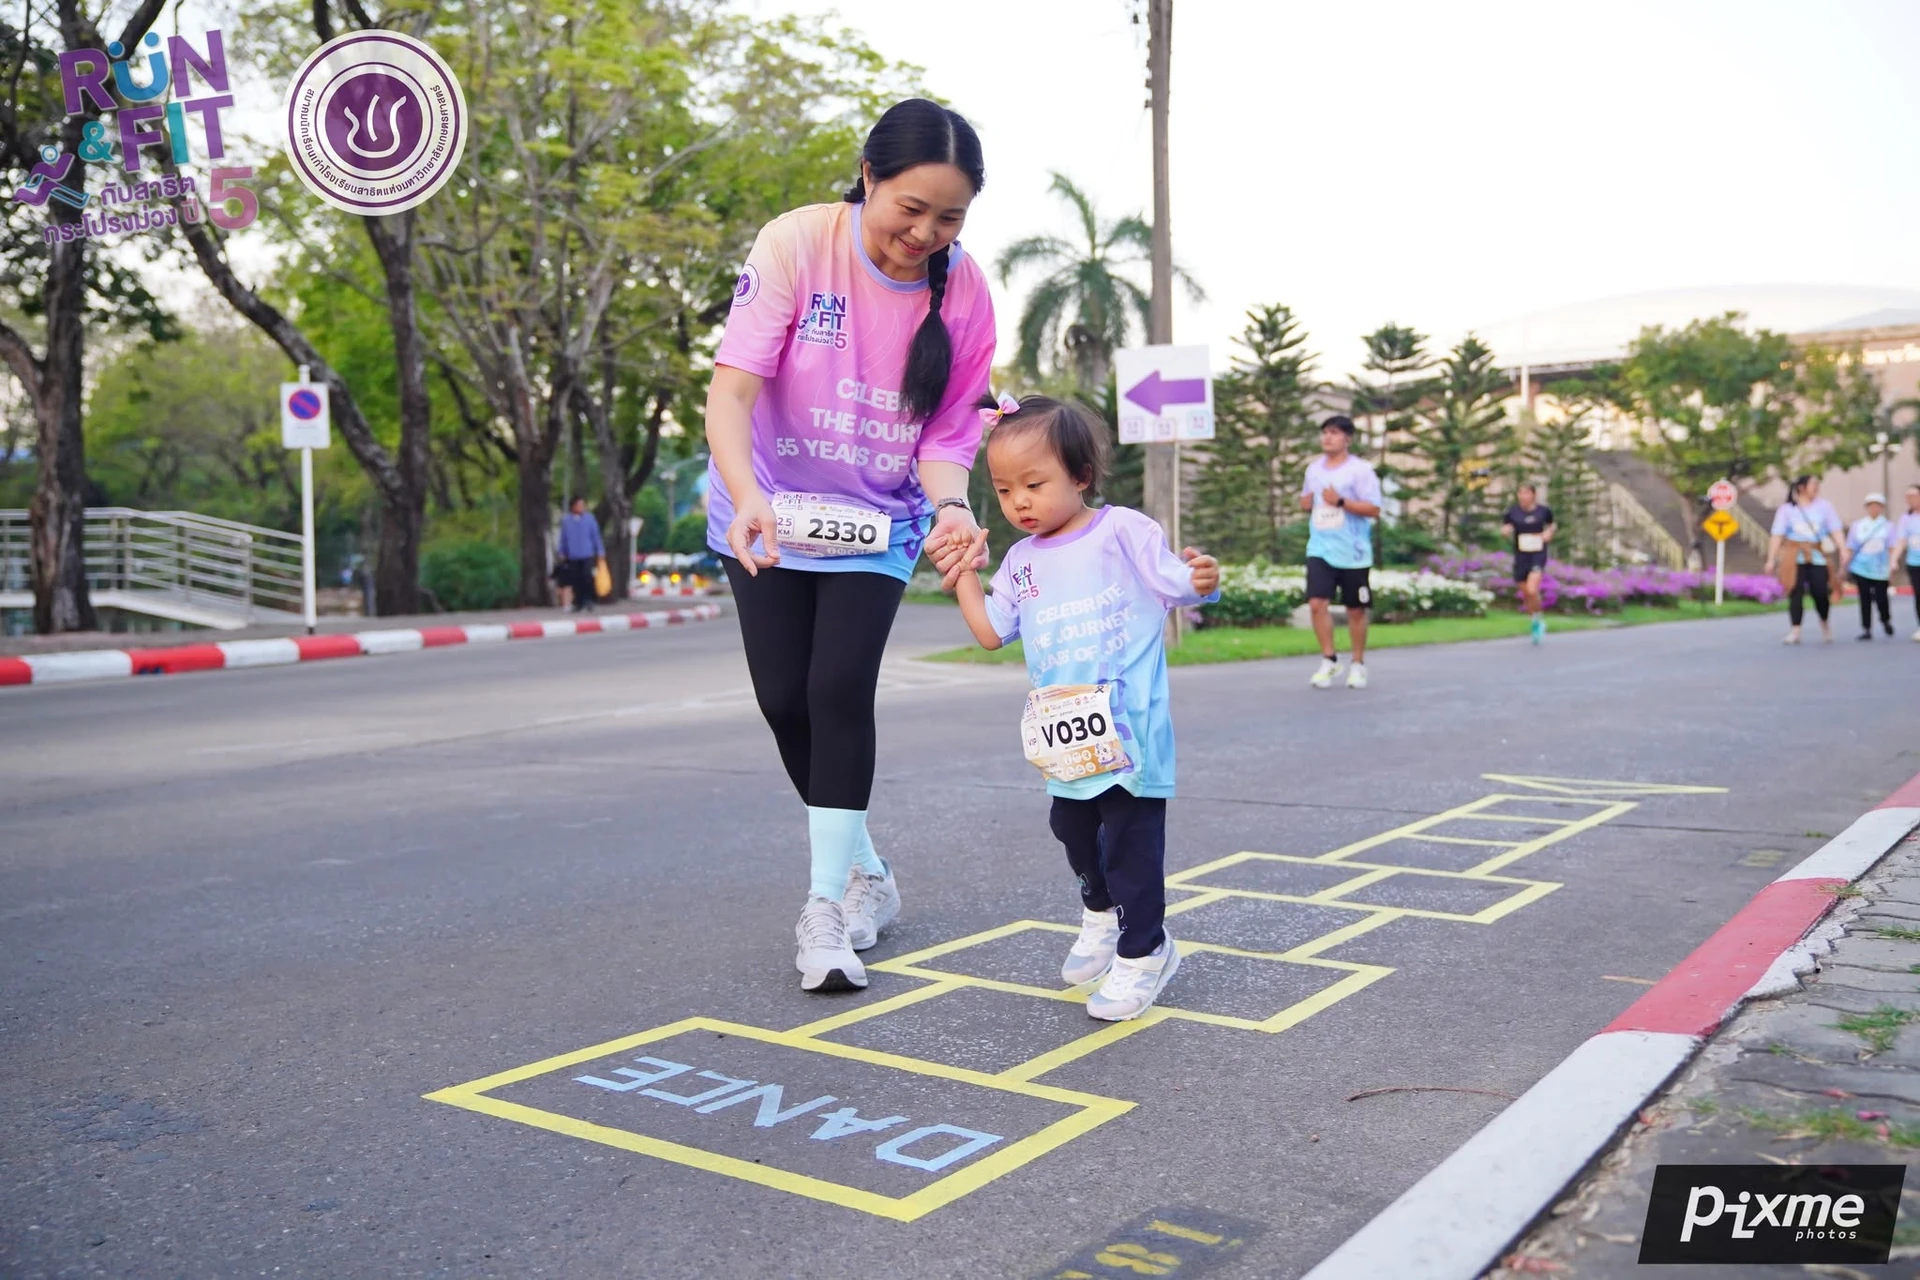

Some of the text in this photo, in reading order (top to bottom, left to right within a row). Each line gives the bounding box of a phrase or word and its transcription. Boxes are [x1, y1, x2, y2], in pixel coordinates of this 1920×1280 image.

[819, 311, 846, 330] FIT
[835, 331, 847, 349] 5
[809, 407, 857, 436] THE
[777, 438, 800, 457] 55
[875, 452, 909, 473] OF
[777, 528, 791, 536] KM
[807, 518, 877, 545] 2330
[1030, 585, 1039, 597] 5
[1036, 582, 1126, 625] CELEBRATE
[1074, 645, 1098, 662] OF
[1104, 628, 1132, 656] JOY
[1041, 713, 1107, 748] V030
[572, 1056, 1004, 1172] DANCE
